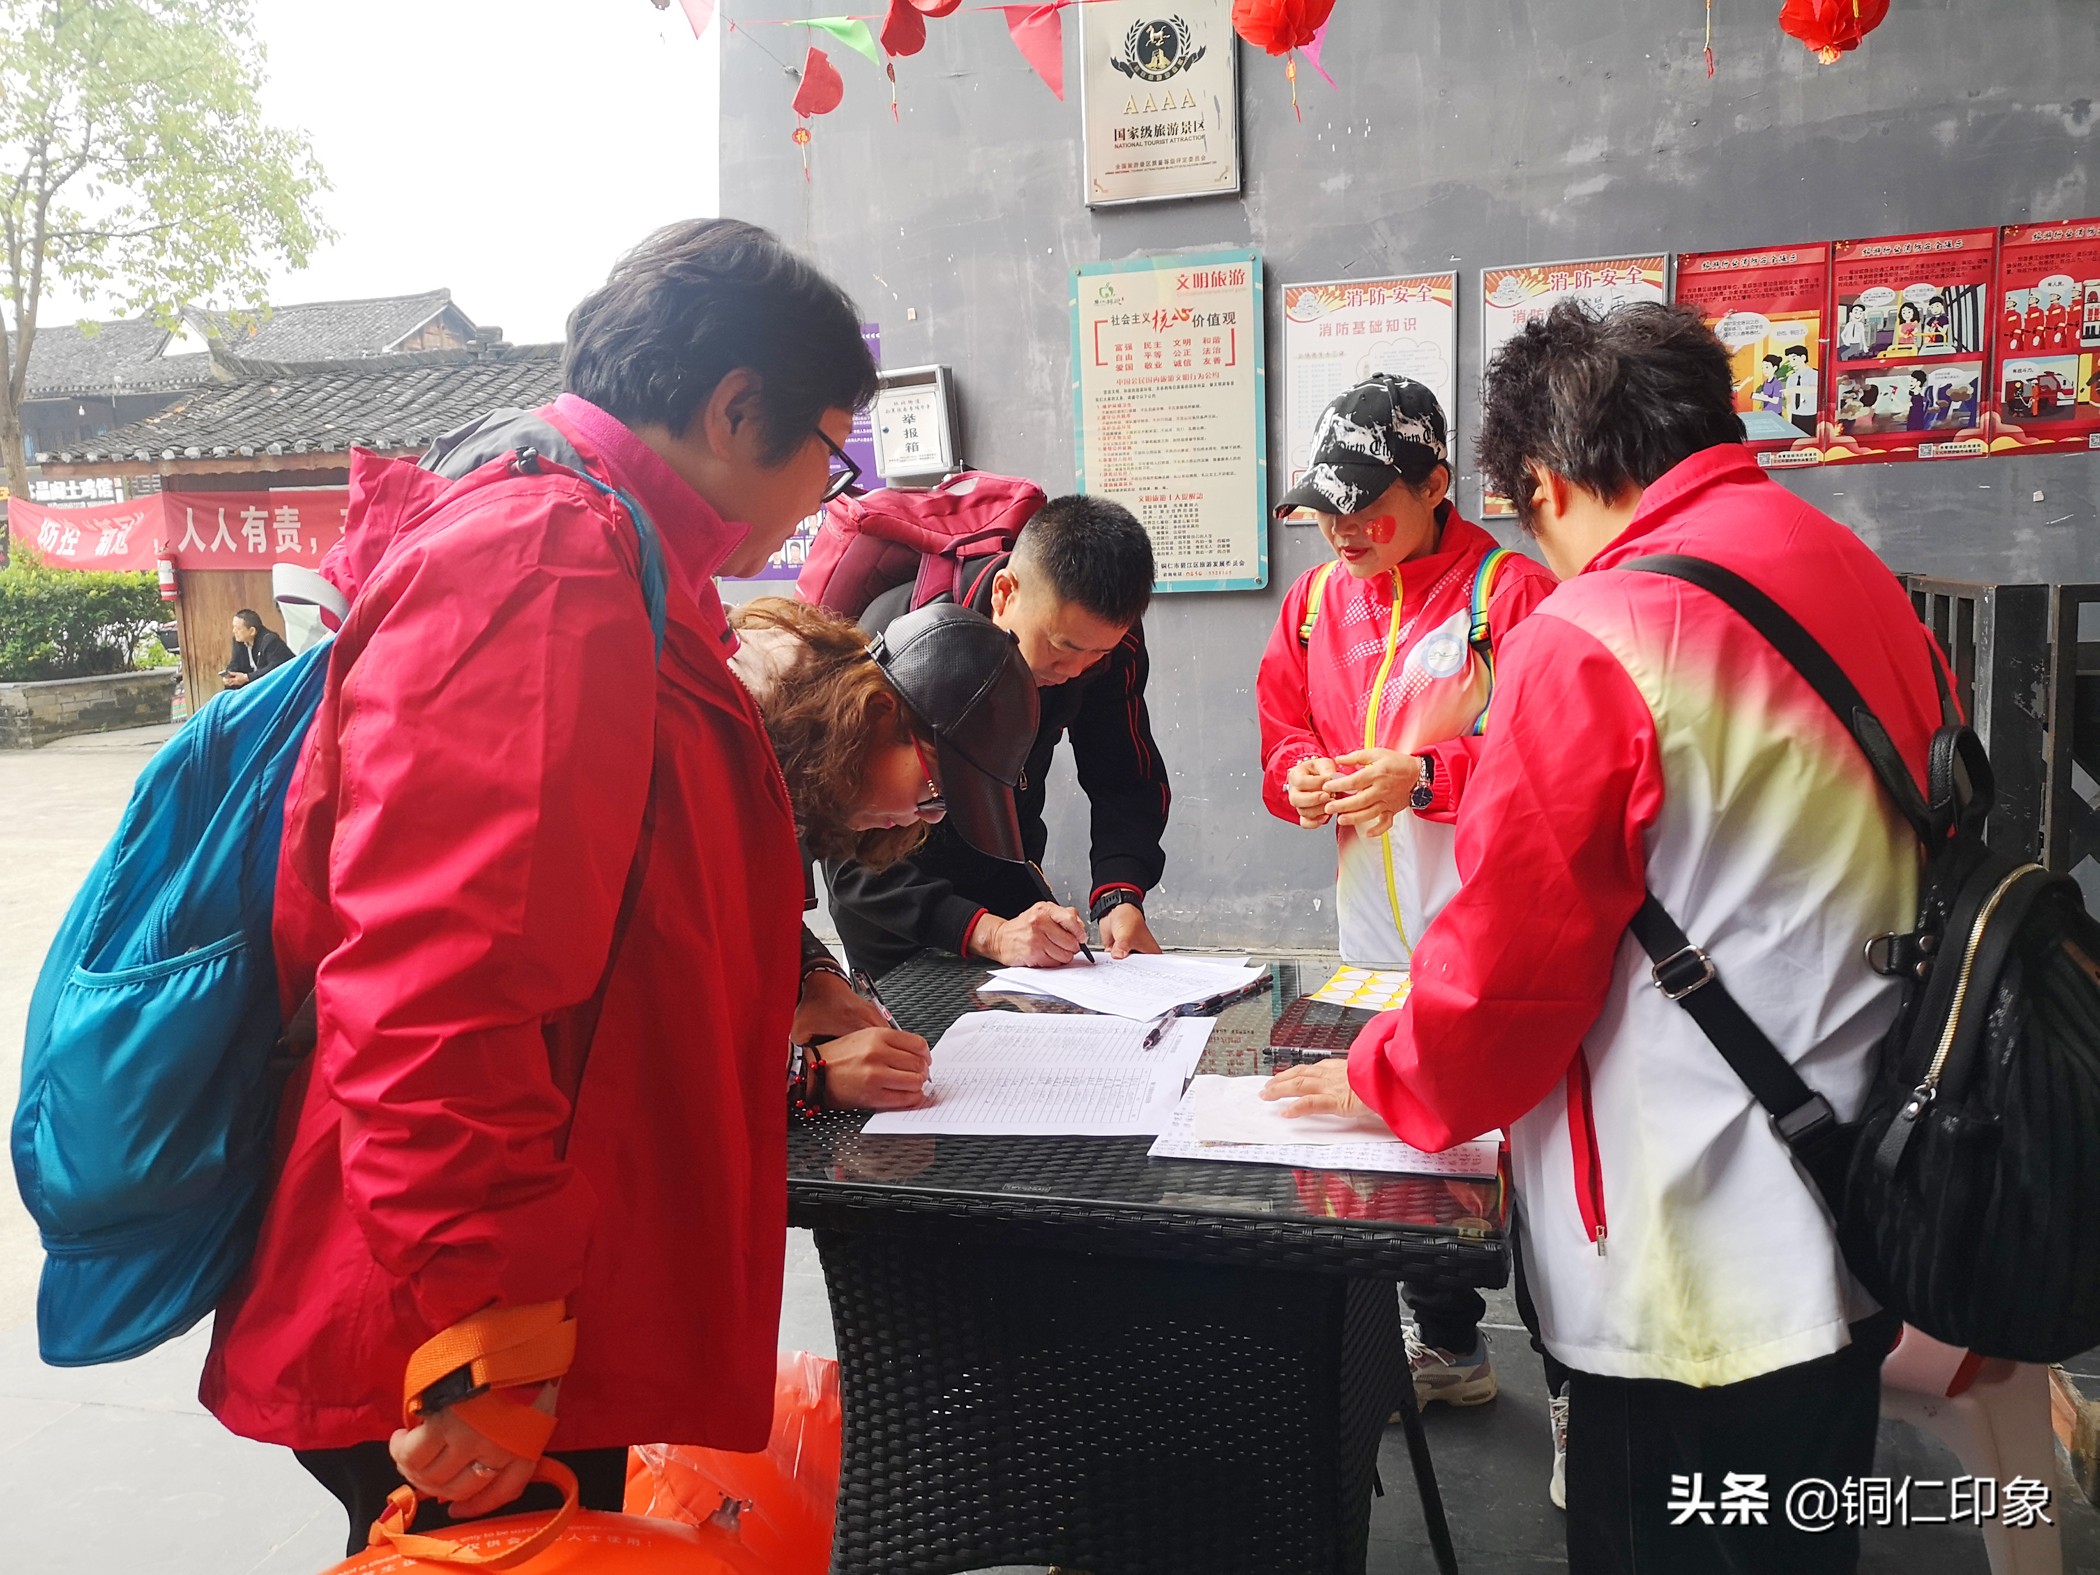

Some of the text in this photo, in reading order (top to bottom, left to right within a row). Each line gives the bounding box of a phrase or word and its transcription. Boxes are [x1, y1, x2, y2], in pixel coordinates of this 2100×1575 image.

[1123, 88, 1197, 116] AAAA
[1114, 120, 1206, 142] 国家级旅游景区
[1114, 140, 1143, 150] NATIONAL
[1144, 138, 1169, 148] TOURIST
[1176, 269, 1246, 291] 文明旅游
[1550, 267, 1644, 291] 消防安全
[1345, 284, 1434, 307] 消防安全
[1111, 307, 1237, 333] 社会主义核心价值观
[1318, 317, 1417, 338] 消防基础知识
[1114, 336, 1221, 351] 富强 民主 文明 和谐
[1115, 346, 1221, 362] 自由 平等 公正 法治
[1115, 357, 1221, 372] 爱国 敬业 诚信 友善
[902, 413, 919, 453] 举报箱
